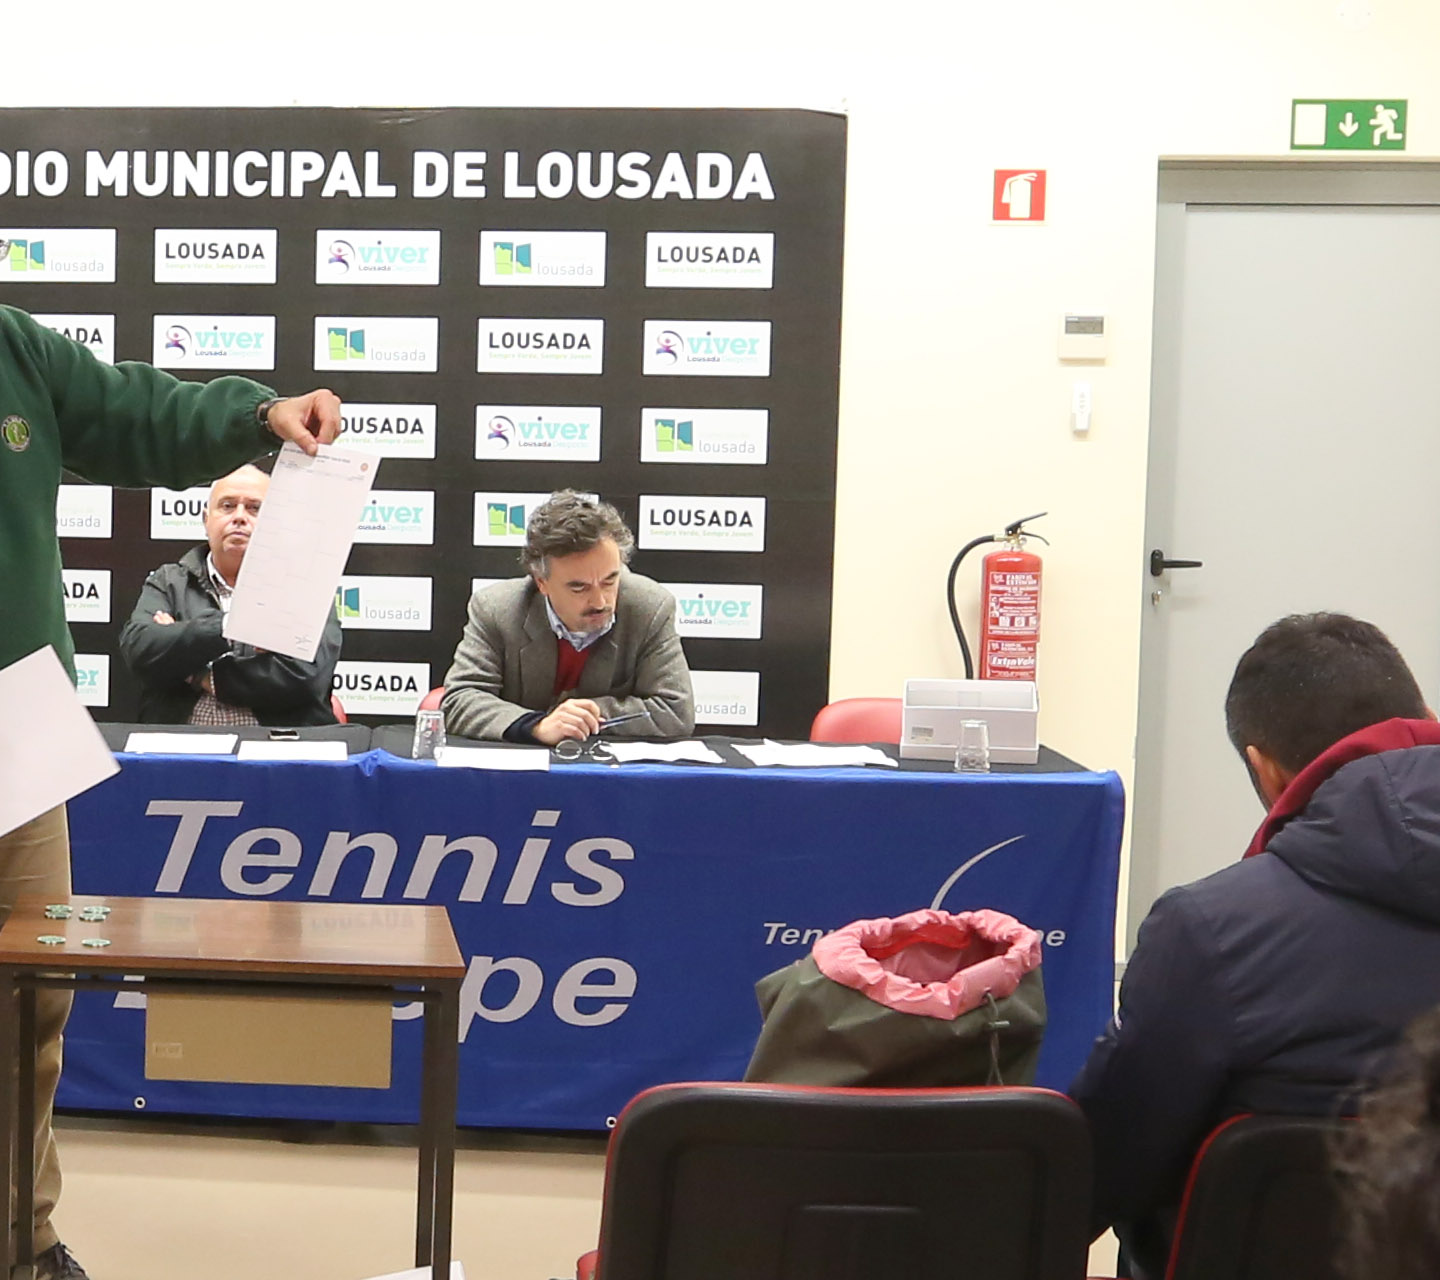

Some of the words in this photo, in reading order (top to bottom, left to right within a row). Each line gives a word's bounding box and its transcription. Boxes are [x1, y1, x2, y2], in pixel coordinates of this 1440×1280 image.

[84, 150, 397, 200] MUNICIPAL
[413, 150, 486, 200] DE
[503, 150, 776, 201] LOUSADA
[165, 242, 265, 260] LOUSADA
[358, 240, 429, 263] viver
[657, 245, 762, 264] LOUSADA
[50, 260, 105, 272] lousada
[537, 263, 594, 275] lousada
[195, 325, 265, 349] viver
[488, 331, 592, 350] LOUSADA
[687, 331, 760, 355] viver
[371, 348, 426, 361] lousada
[518, 416, 591, 440] viver
[699, 440, 756, 453] lousada
[57, 515, 101, 528] usada
[649, 508, 754, 528] LOUSADA
[365, 606, 421, 620] lousada
[679, 593, 752, 618] viver
[333, 673, 419, 693] OUSADA
[695, 702, 747, 715] ousada
[144, 799, 635, 907] Tennis
